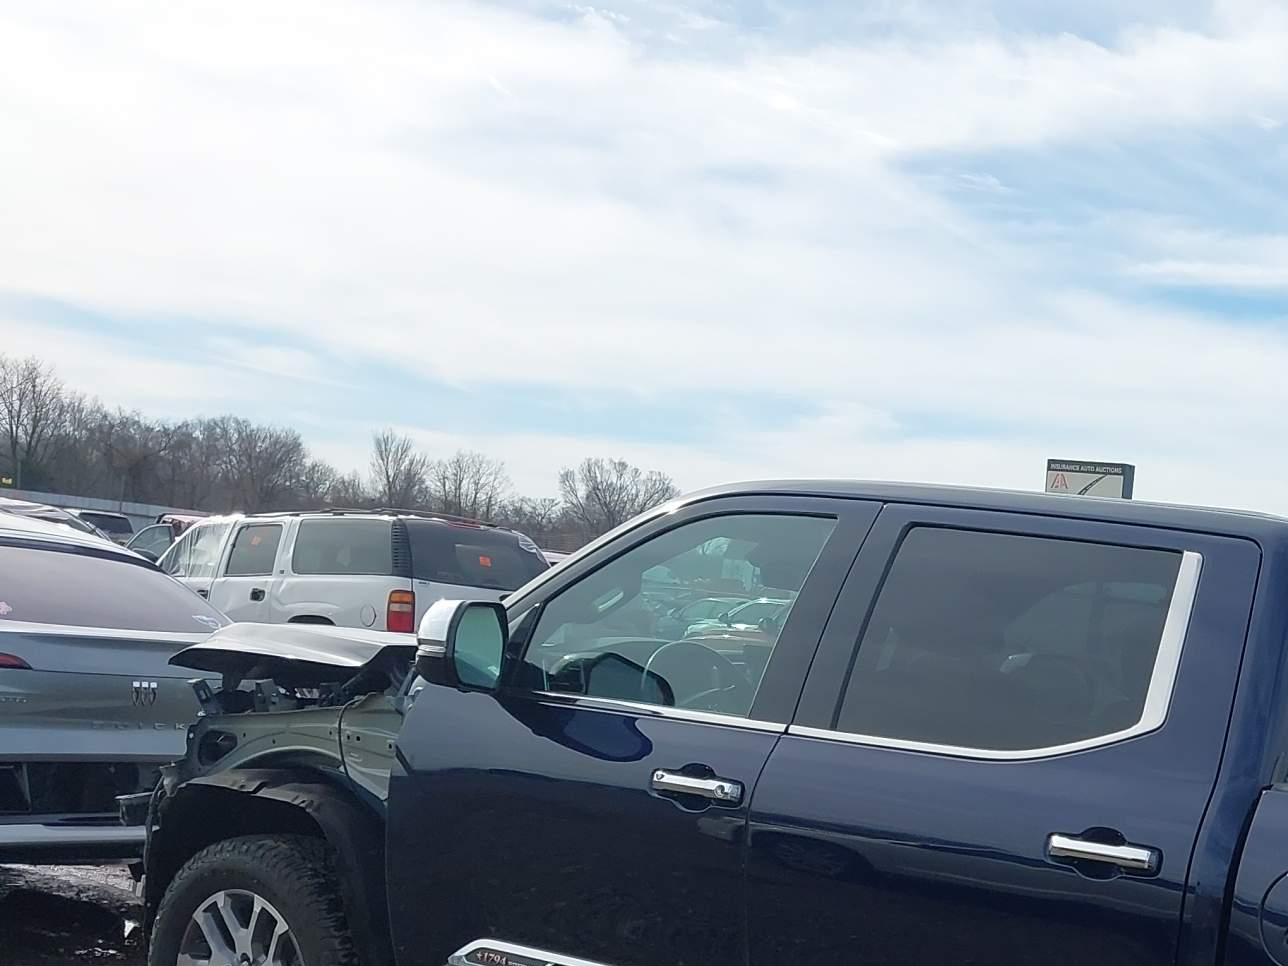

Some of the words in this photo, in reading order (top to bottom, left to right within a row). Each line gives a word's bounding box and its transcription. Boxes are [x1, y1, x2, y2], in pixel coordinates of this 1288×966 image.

[1080, 464, 1095, 472] AUTO
[1096, 465, 1123, 474] AUCTIONS
[484, 952, 507, 966] 1794
